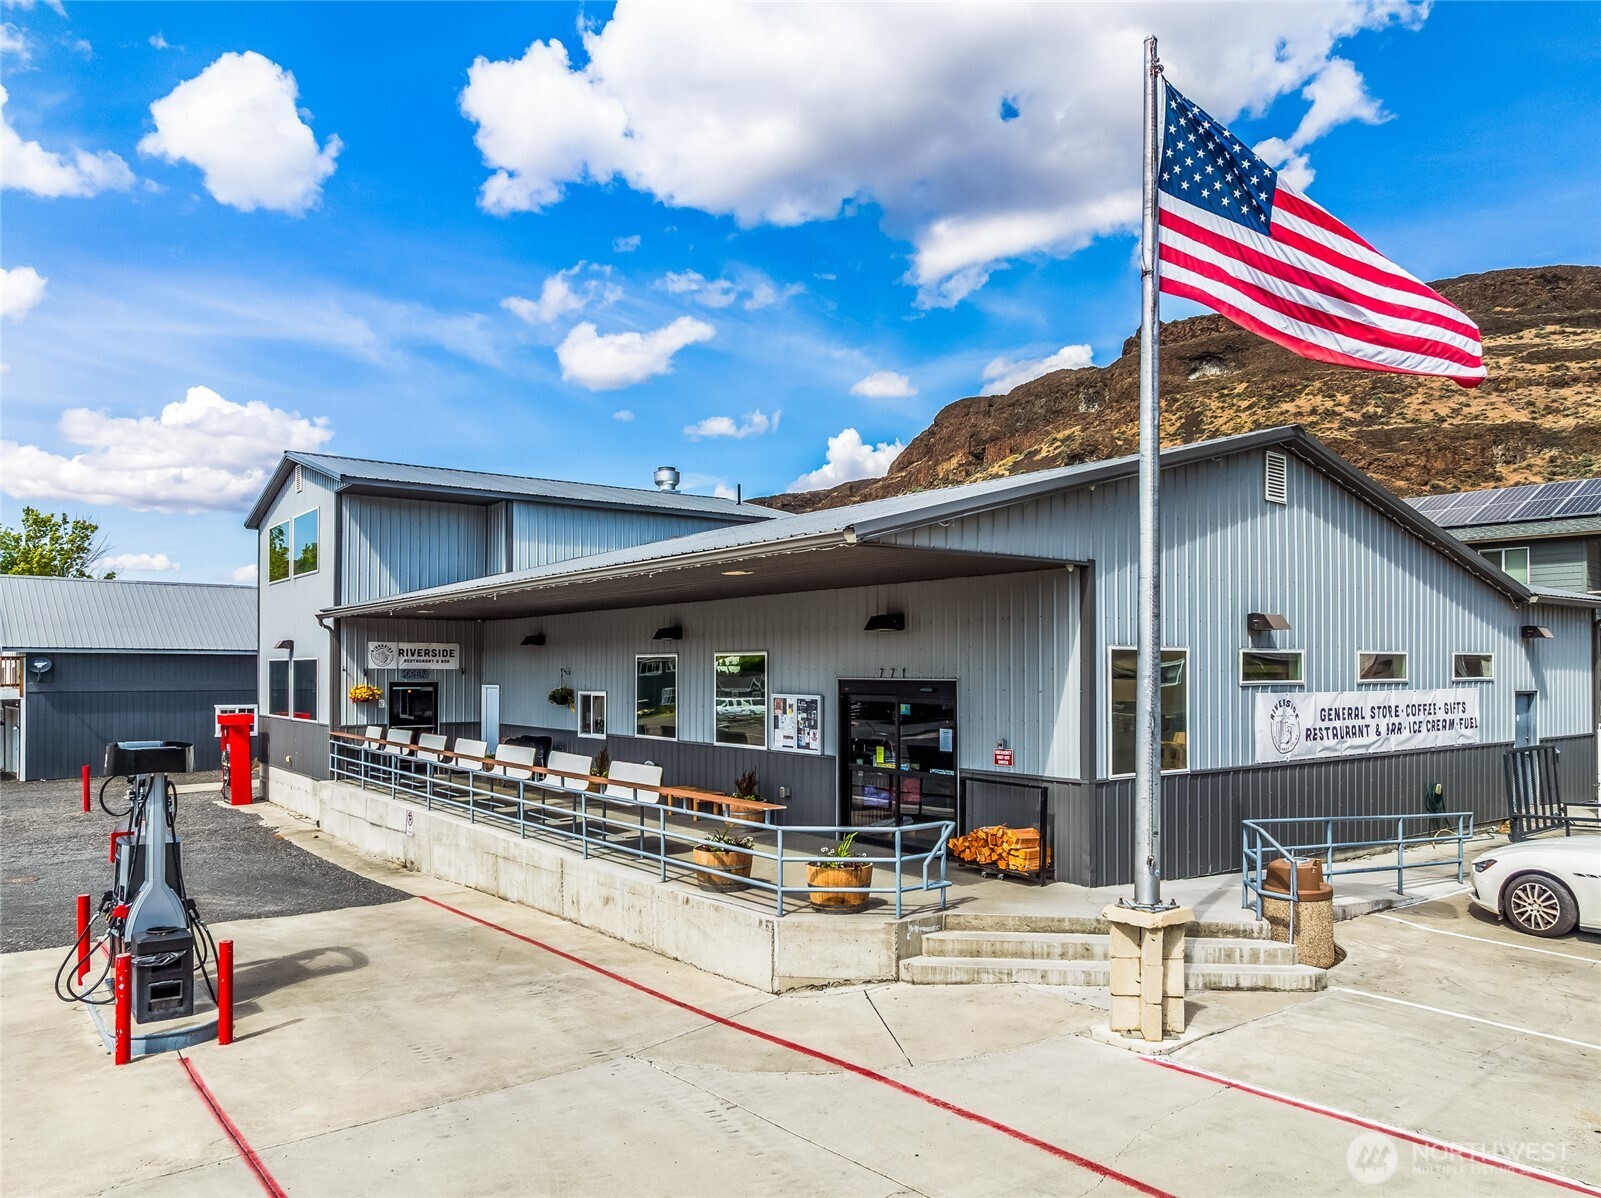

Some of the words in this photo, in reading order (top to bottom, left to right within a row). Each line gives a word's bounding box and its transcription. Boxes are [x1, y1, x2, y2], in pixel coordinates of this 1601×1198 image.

[398, 648, 456, 658] RIVERSIDE
[1320, 706, 1365, 722] GENERAL
[1370, 704, 1399, 720] STORE
[1405, 702, 1436, 717] COFFEE
[1444, 701, 1466, 715] GIFTS
[1305, 724, 1370, 742] RESTAURANT
[1375, 724, 1382, 737] &
[1408, 721, 1423, 734] ICE
[1426, 718, 1455, 732] CREAM
[1459, 717, 1478, 730] FUEL
